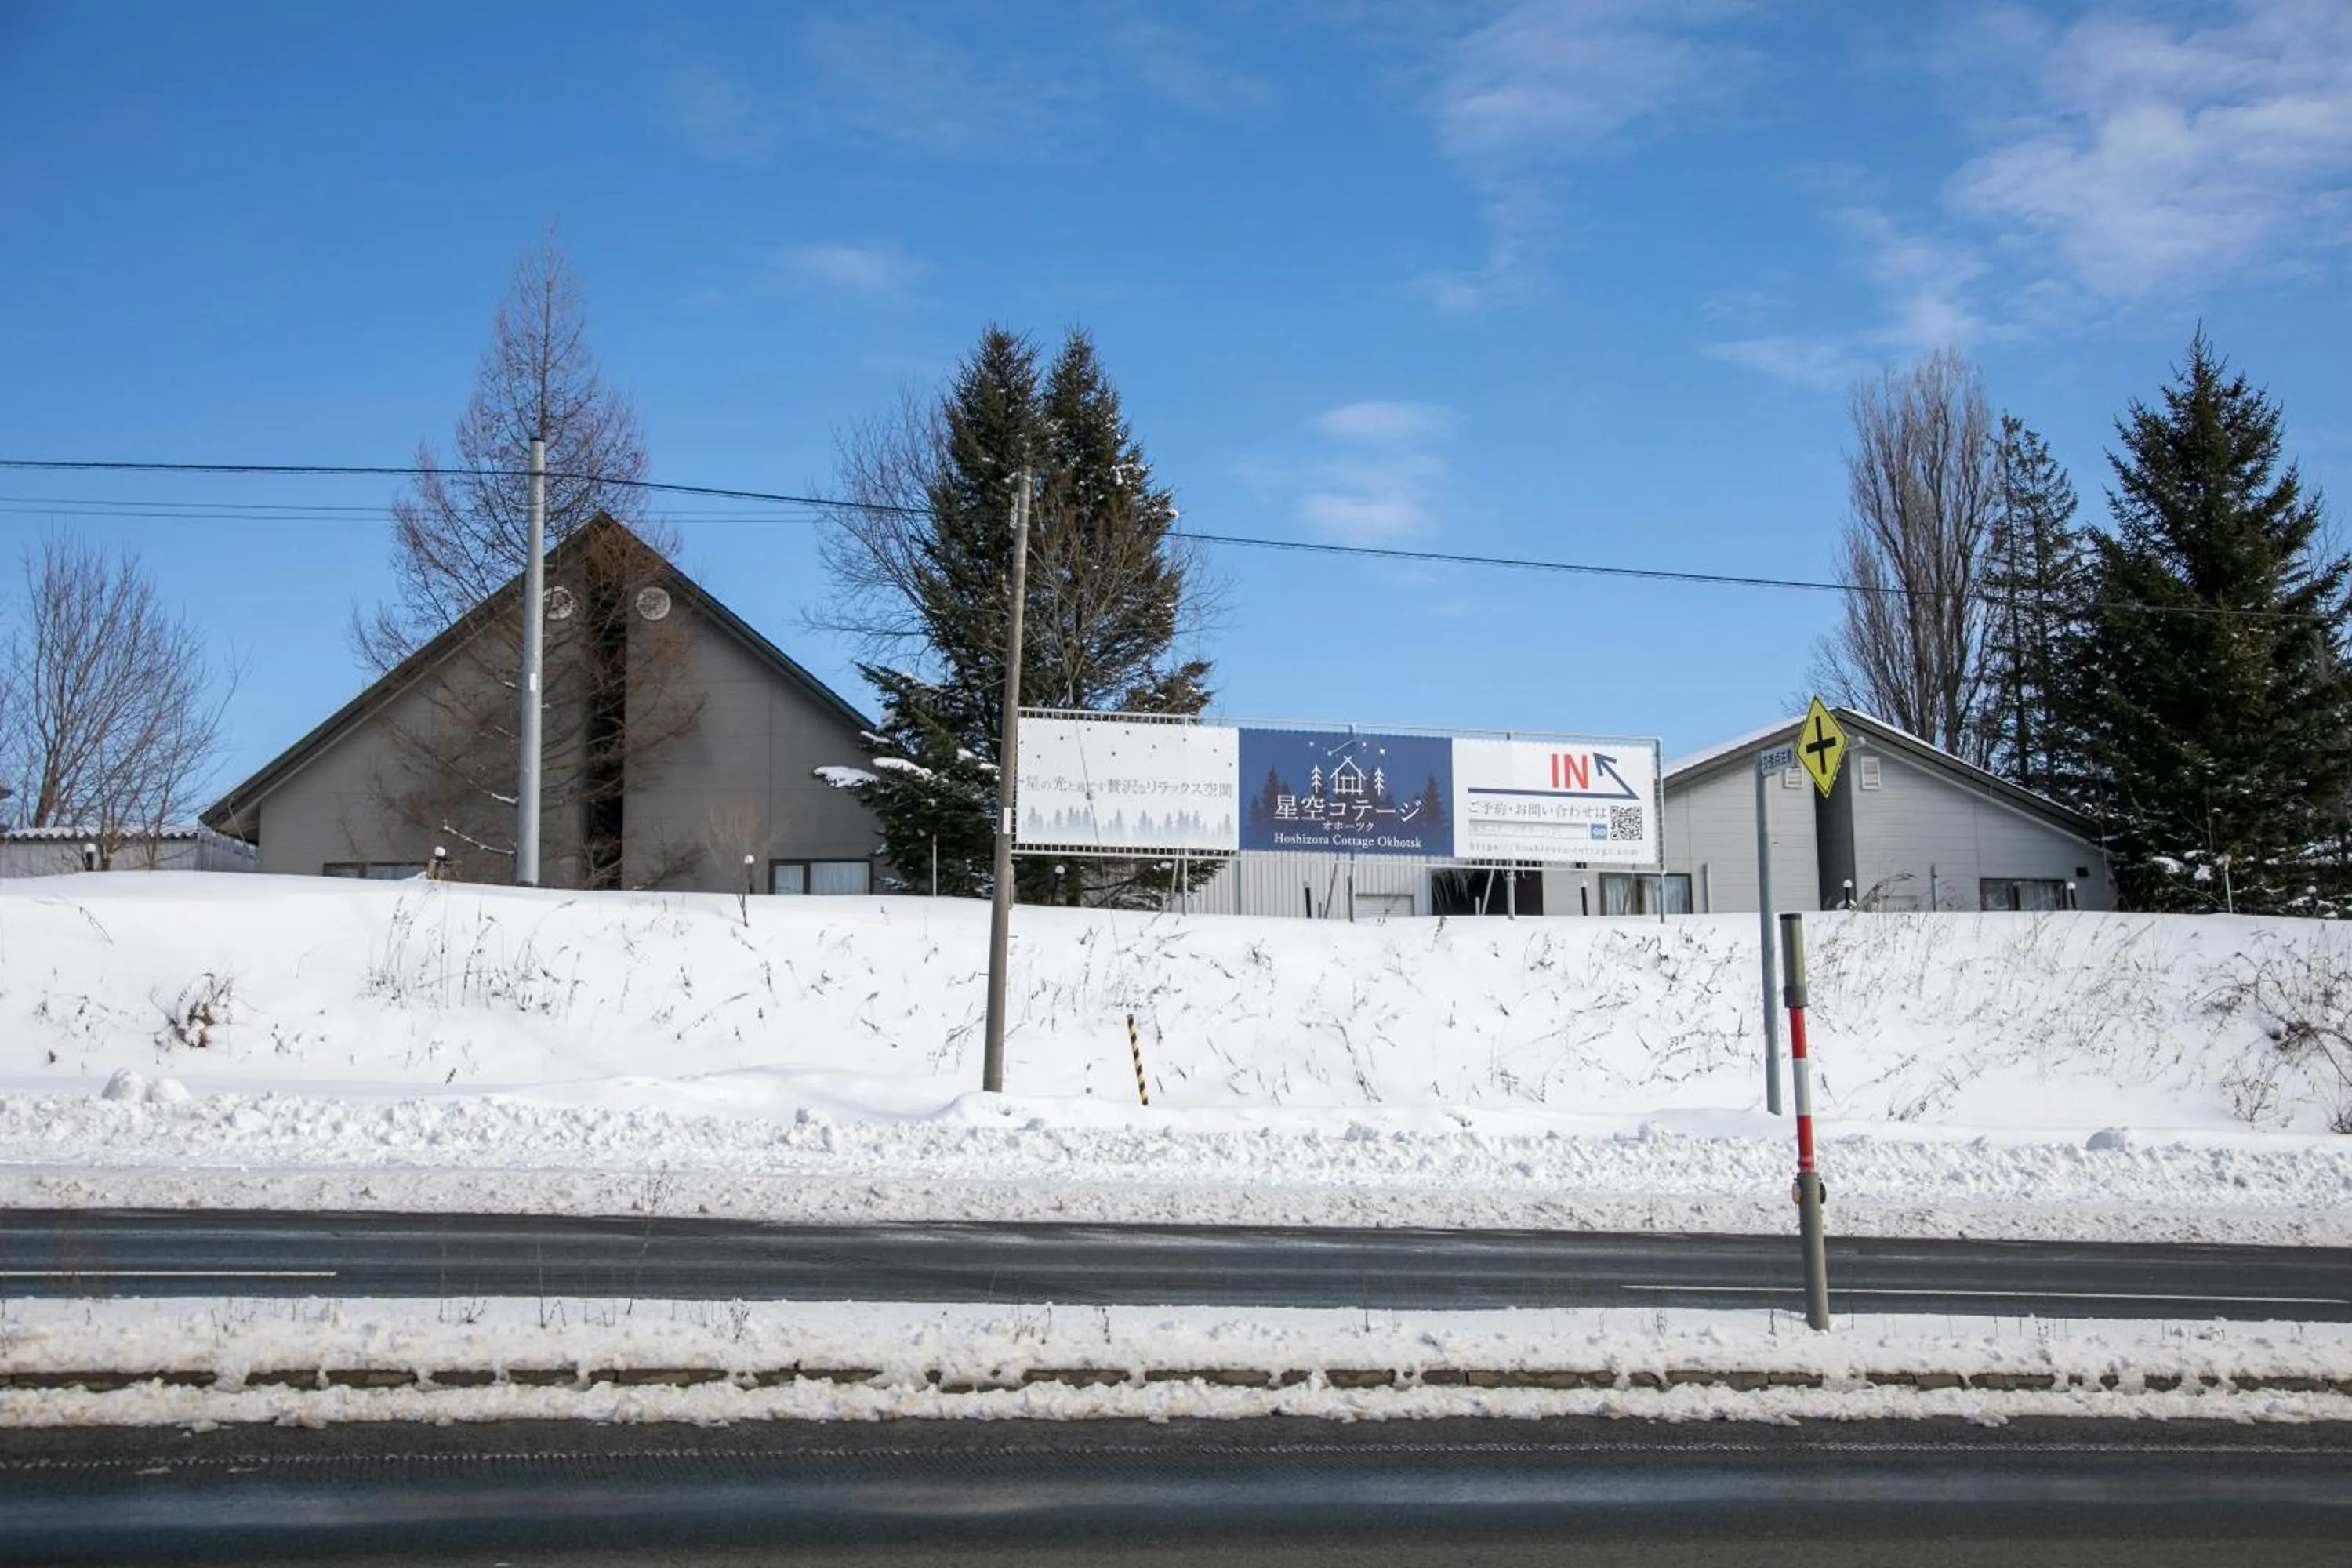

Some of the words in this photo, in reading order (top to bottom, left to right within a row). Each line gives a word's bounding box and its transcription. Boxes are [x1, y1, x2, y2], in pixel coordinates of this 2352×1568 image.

[1551, 753, 1589, 789] IN
[1273, 794, 1422, 822] 星空コテージ
[1322, 822, 1374, 832] オホーツク
[1273, 832, 1329, 844] Hoshizora
[1332, 834, 1374, 848] Cottage
[1377, 836, 1422, 848] Okhotsk
